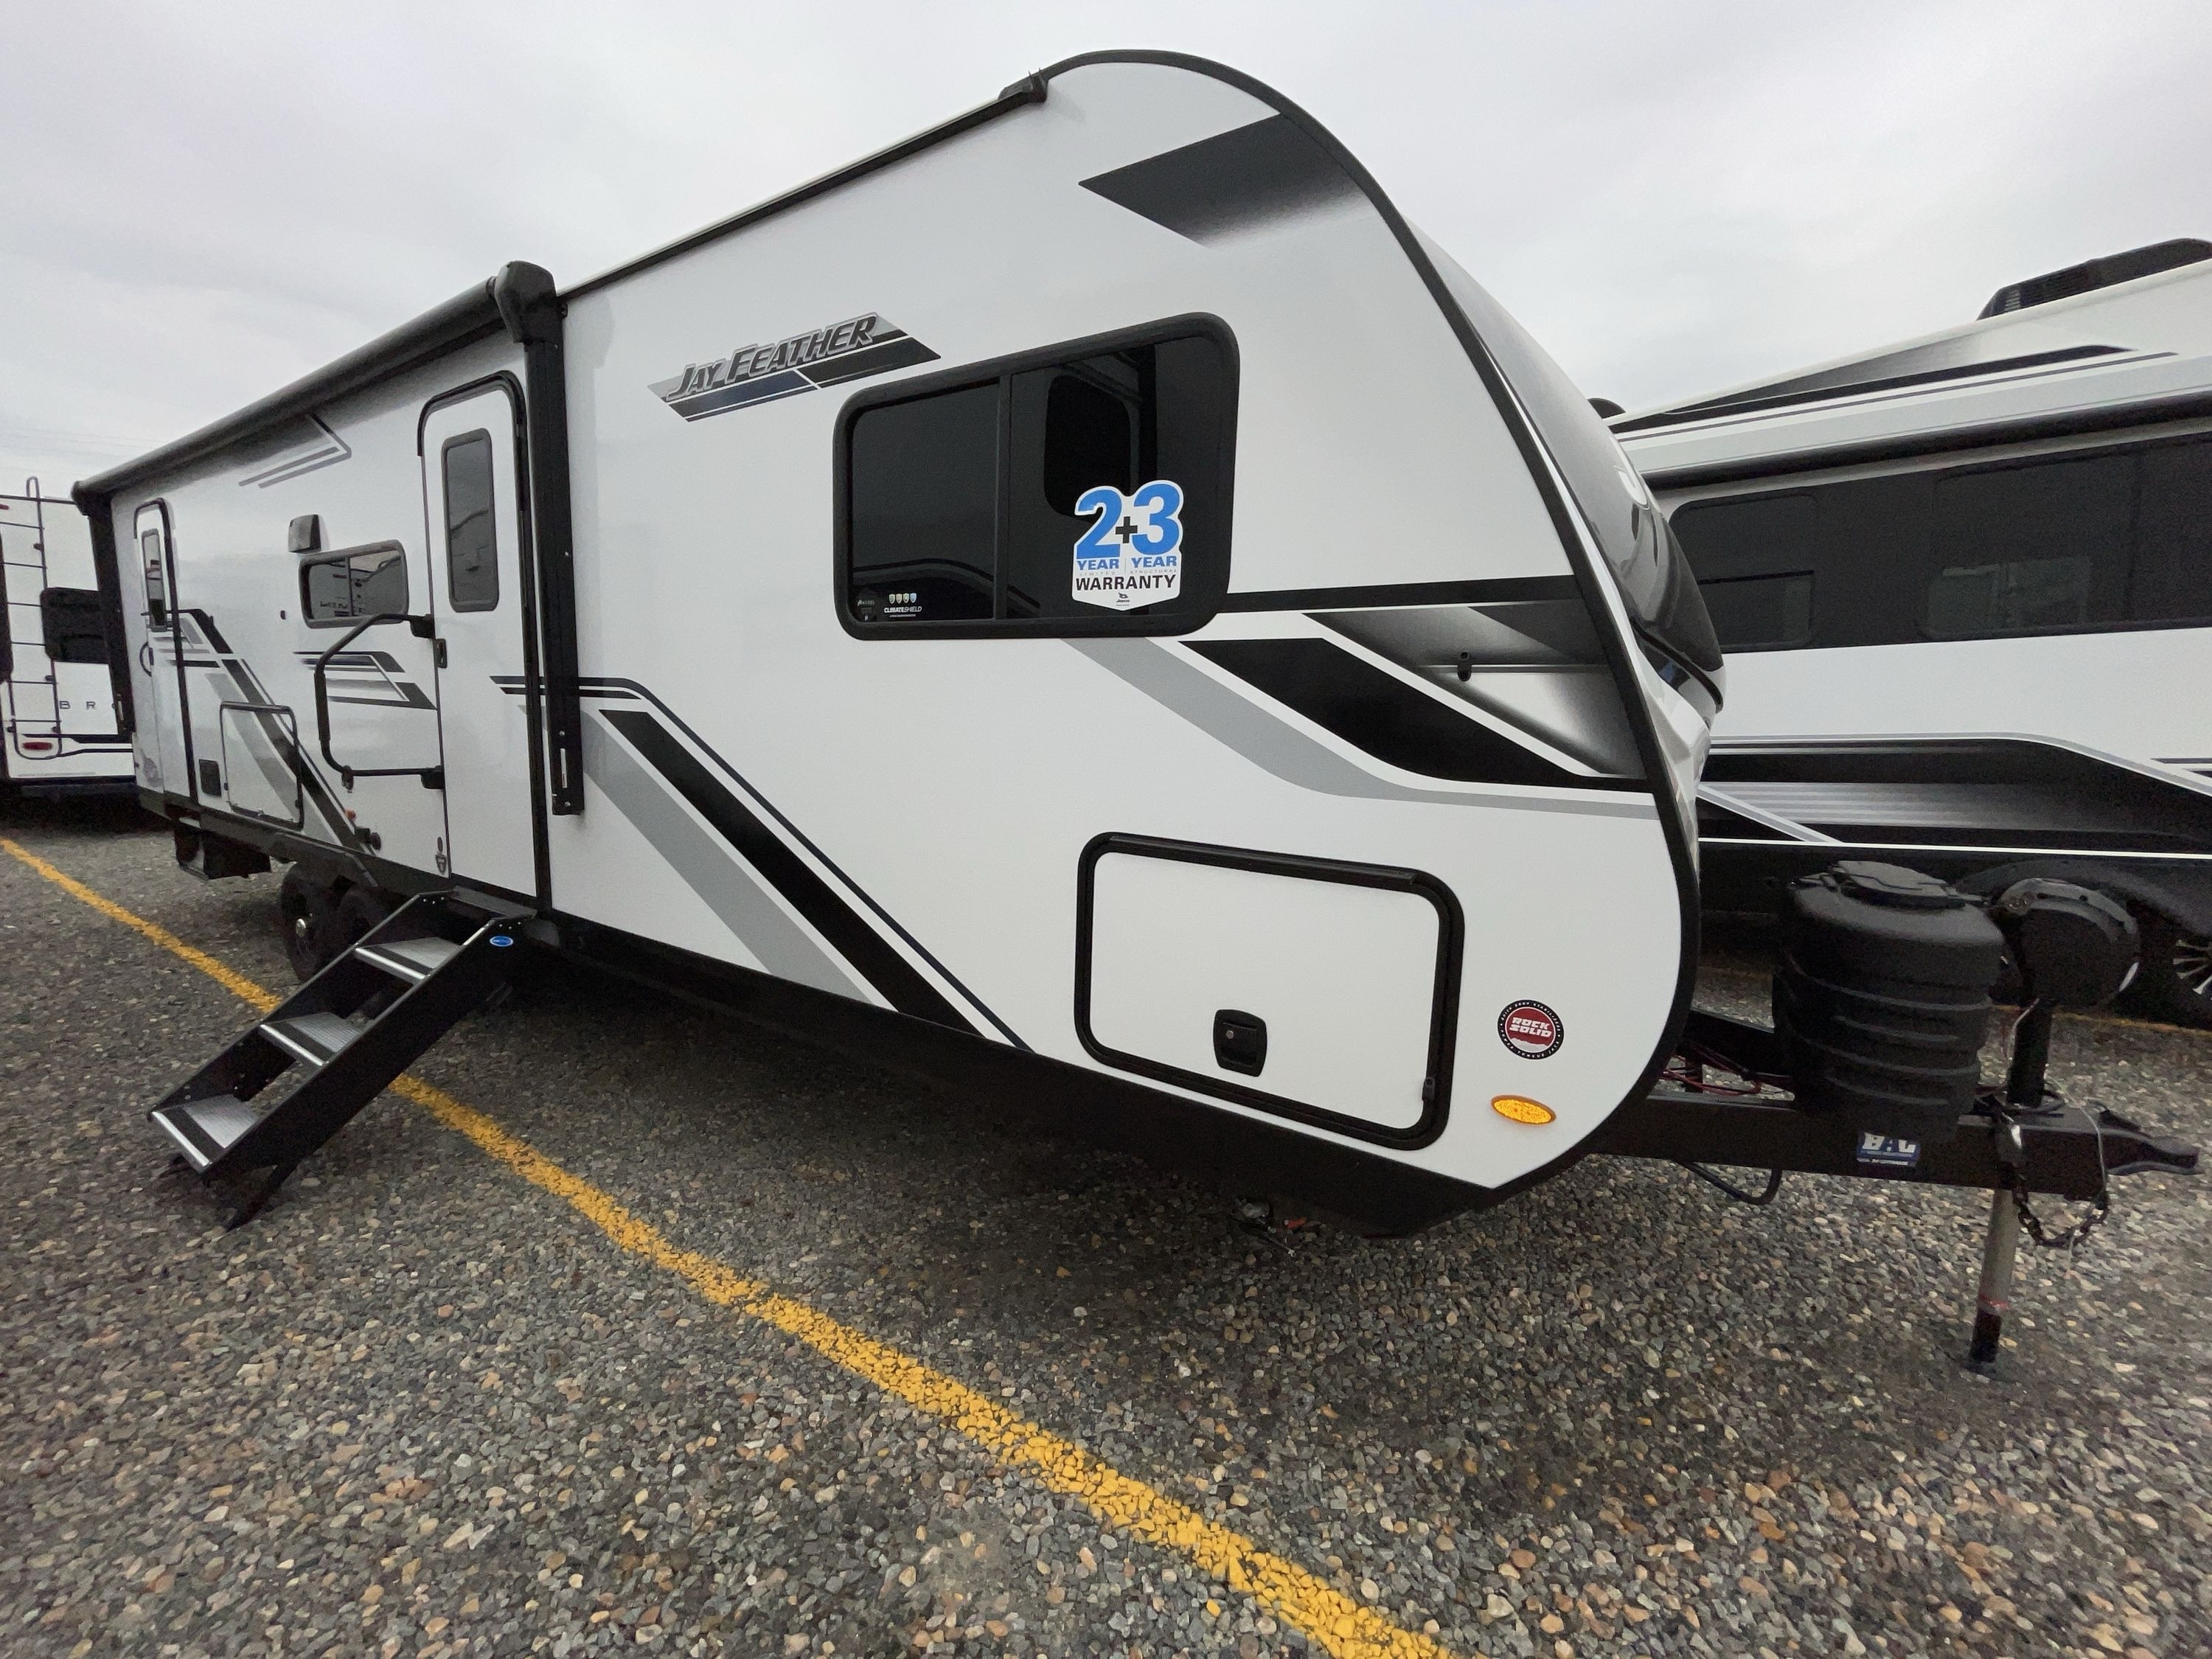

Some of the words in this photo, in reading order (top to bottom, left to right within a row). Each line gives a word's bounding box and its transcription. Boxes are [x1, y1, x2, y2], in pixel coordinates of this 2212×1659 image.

[666, 359, 726, 401] JAY
[724, 313, 879, 383] FEATHER
[1077, 559, 1119, 571] YEAR
[1131, 556, 1177, 568] YEAR
[1076, 574, 1177, 591] WARRANTY
[1509, 1023, 1552, 1037] SOLID
[1512, 1017, 1550, 1030] ROCK
